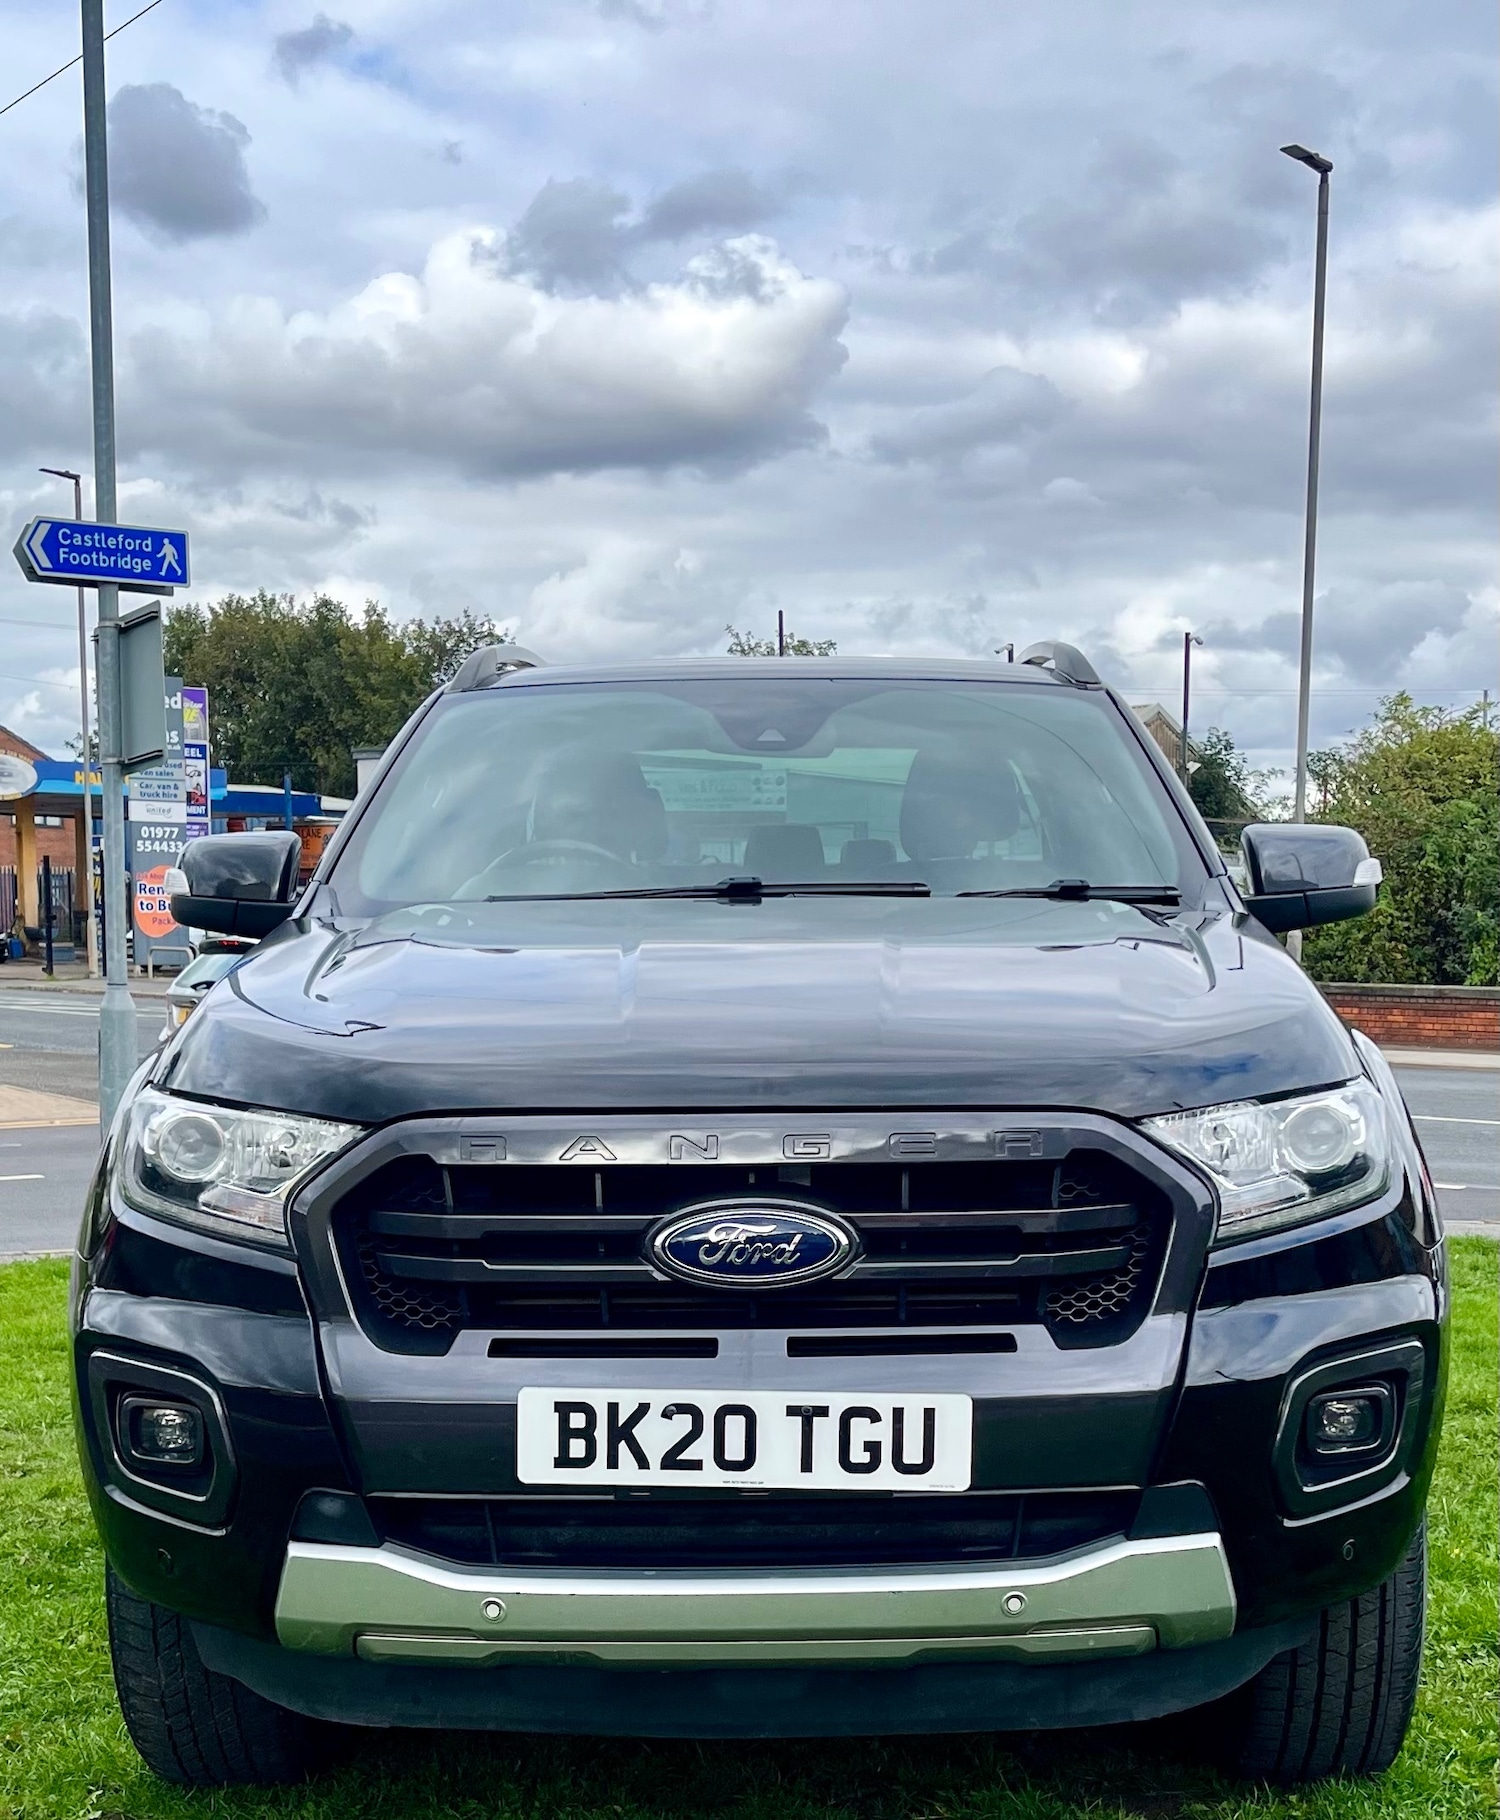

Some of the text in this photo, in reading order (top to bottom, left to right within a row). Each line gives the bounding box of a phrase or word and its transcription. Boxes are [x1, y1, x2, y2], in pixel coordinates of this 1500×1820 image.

[58, 528, 152, 552] Castleford
[59, 548, 152, 573] Footbridge
[155, 769, 175, 777] sales
[140, 791, 160, 799] truck
[141, 826, 179, 839] 01977
[136, 840, 183, 853] 554433
[139, 900, 154, 911] to
[460, 1131, 1043, 1162] RANGER
[699, 1223, 802, 1265] Ford
[553, 1401, 936, 1475] BK20 TGU
